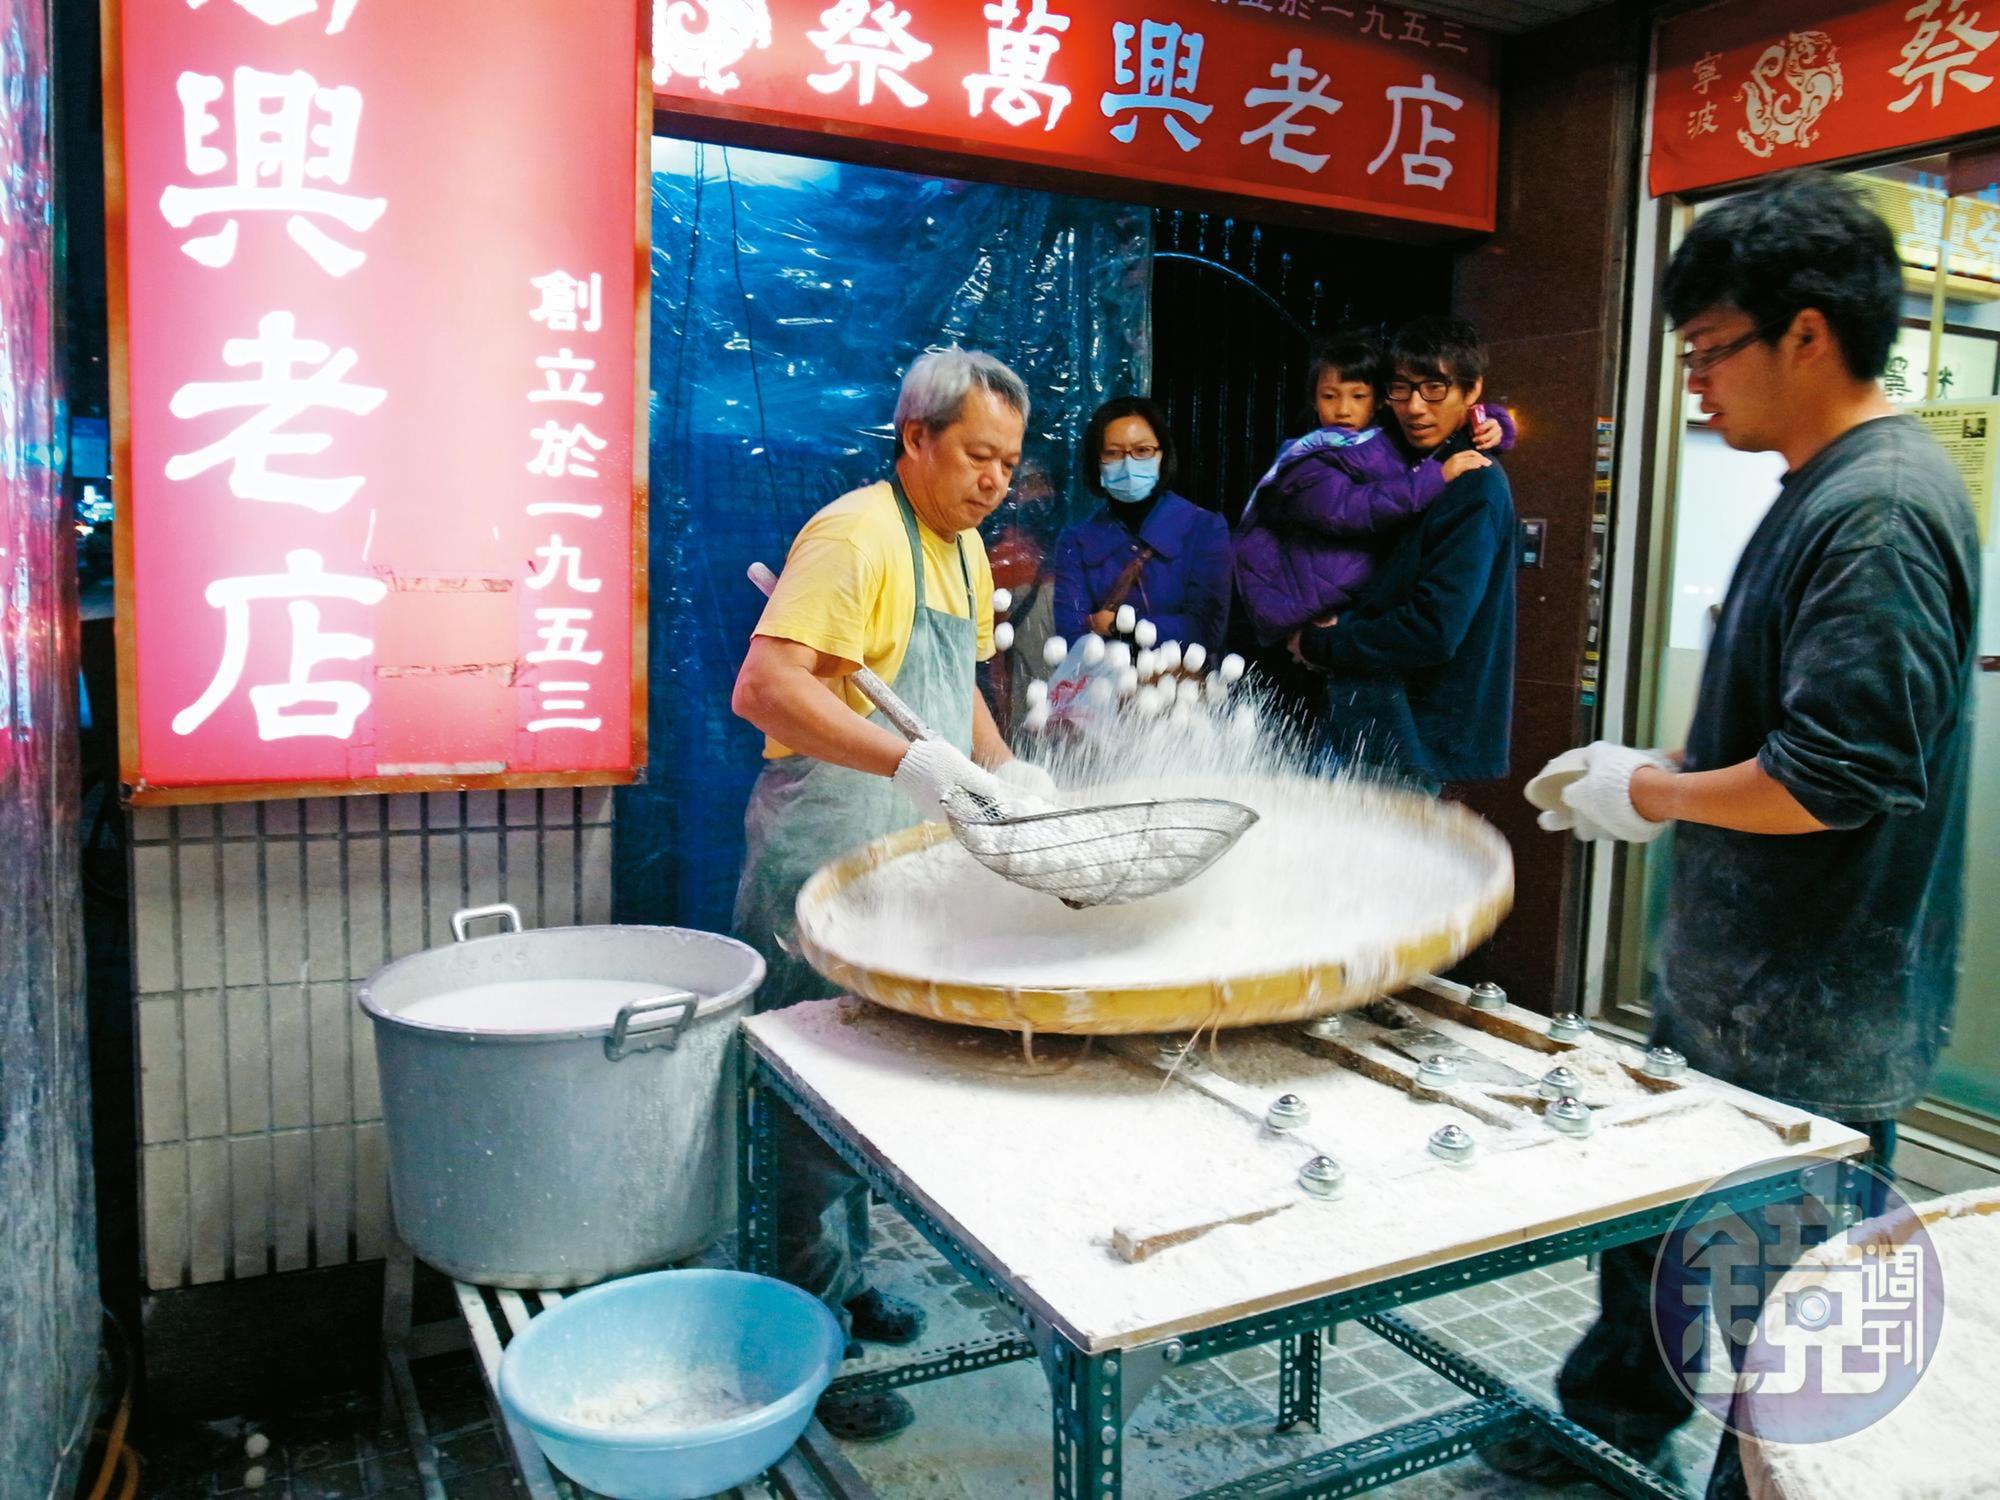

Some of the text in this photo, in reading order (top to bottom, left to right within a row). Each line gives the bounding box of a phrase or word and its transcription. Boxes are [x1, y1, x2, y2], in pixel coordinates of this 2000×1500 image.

[1887, 0, 2000, 113] 蔡
[160, 0, 388, 741] 興老店
[525, 269, 607, 733] 創立於一九五三
